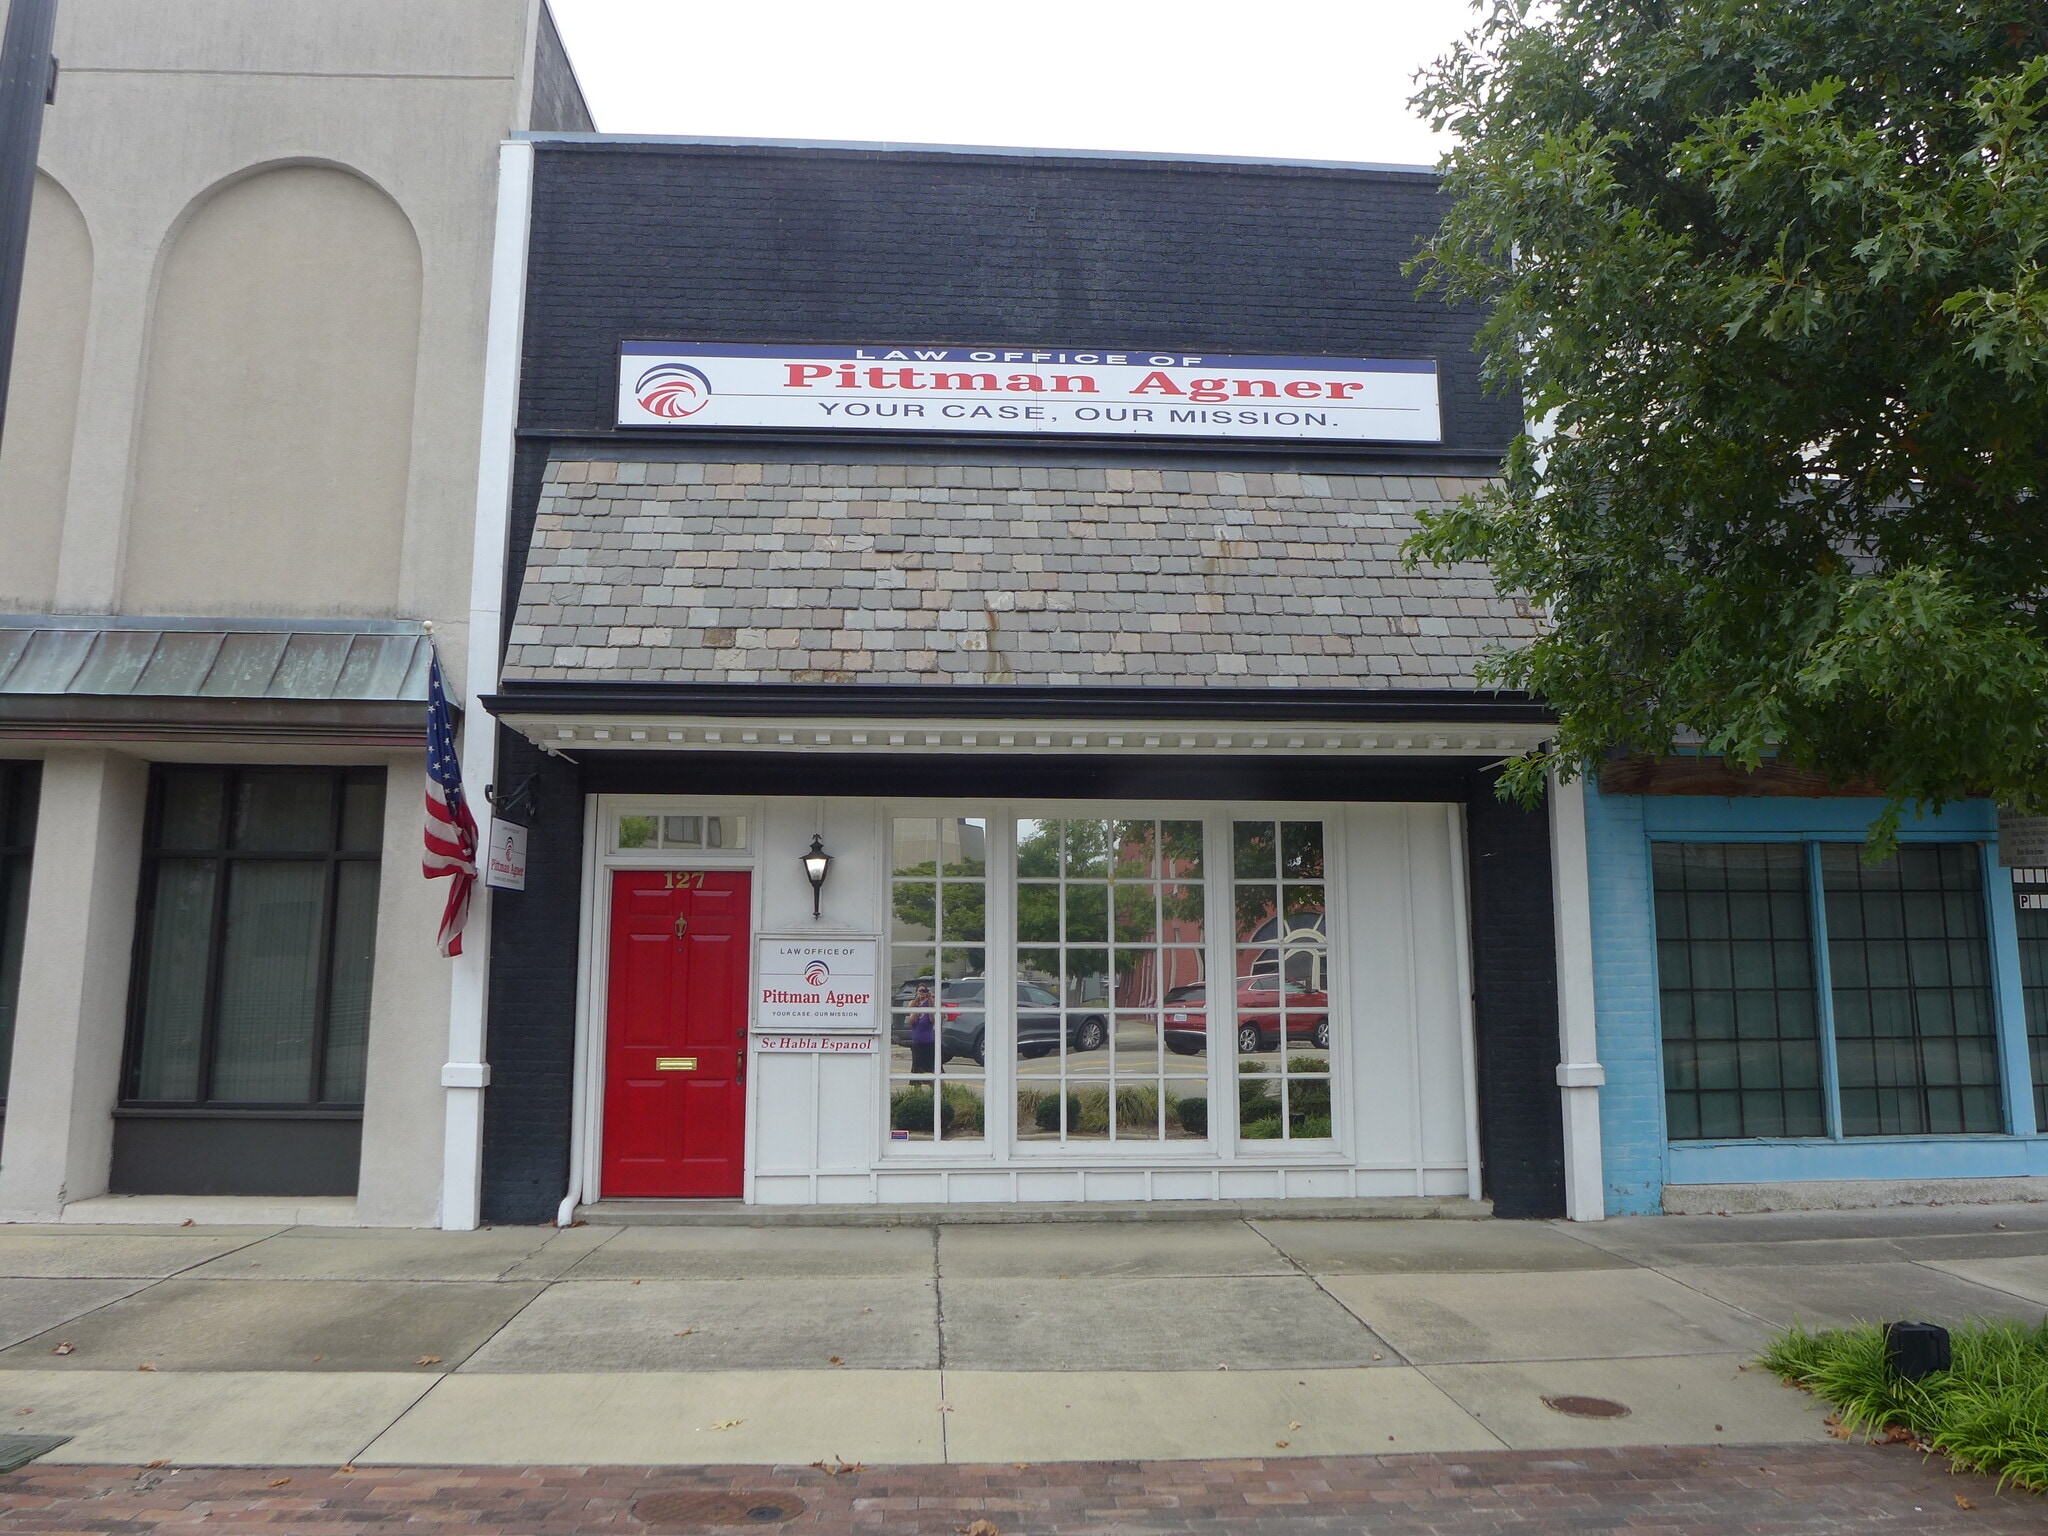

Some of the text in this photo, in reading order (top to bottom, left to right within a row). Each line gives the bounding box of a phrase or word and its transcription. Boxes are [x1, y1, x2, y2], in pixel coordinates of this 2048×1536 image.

[857, 350, 1202, 366] LAW OFFICE OF
[783, 363, 1364, 402] Pittman Agner
[818, 402, 1338, 427] YOUR CASE, OUR MISSION.
[664, 871, 705, 889] 127
[762, 989, 870, 1007] Pittman Agner
[761, 1037, 872, 1051] Se Habla Espanol
